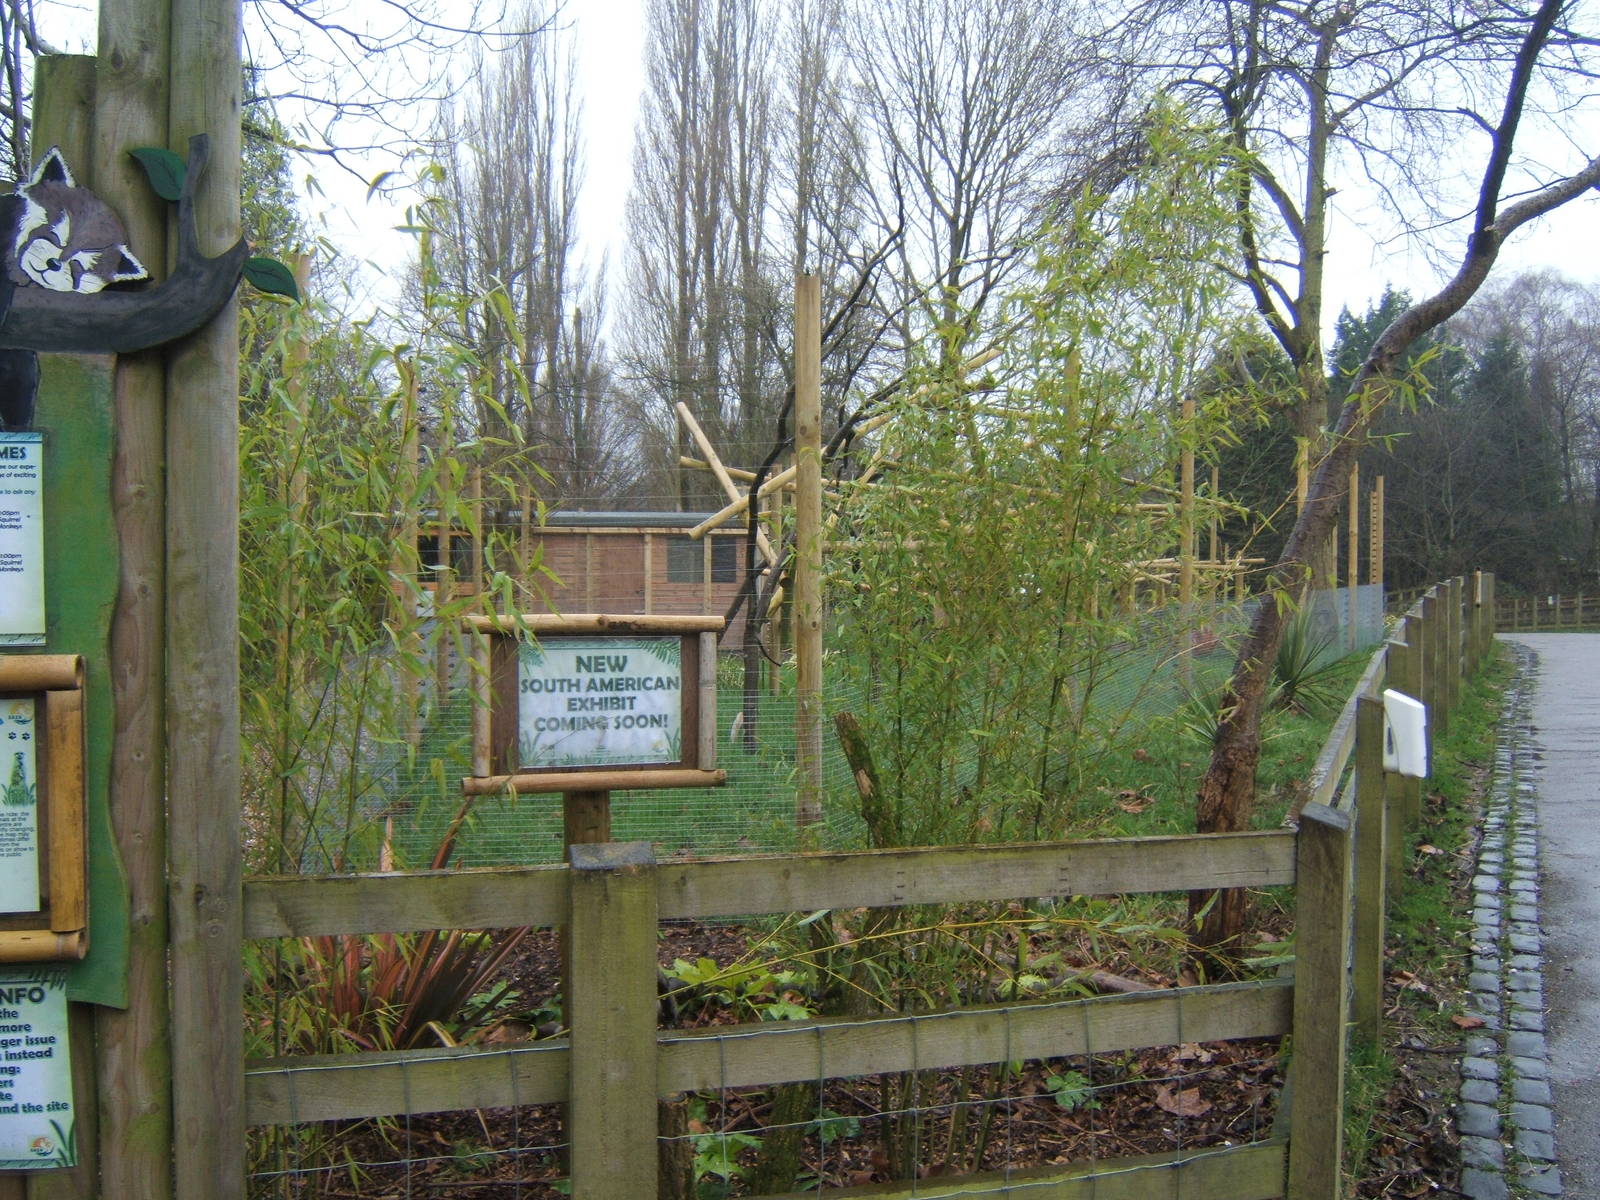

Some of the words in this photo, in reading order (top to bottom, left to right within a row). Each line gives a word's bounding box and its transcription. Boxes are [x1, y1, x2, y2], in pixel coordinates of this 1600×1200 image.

[575, 655, 628, 673] NEW
[520, 678, 581, 694] SOUTH
[585, 676, 680, 692] AMERICAN
[567, 696, 637, 712] EXHIBIT
[534, 715, 609, 732] COMING
[613, 714, 669, 730] SOON!
[0, 1024, 31, 1033] more
[25, 1035, 56, 1046] issue
[5, 1047, 52, 1060] instead
[22, 1102, 43, 1113] the
[46, 1101, 69, 1112] site
